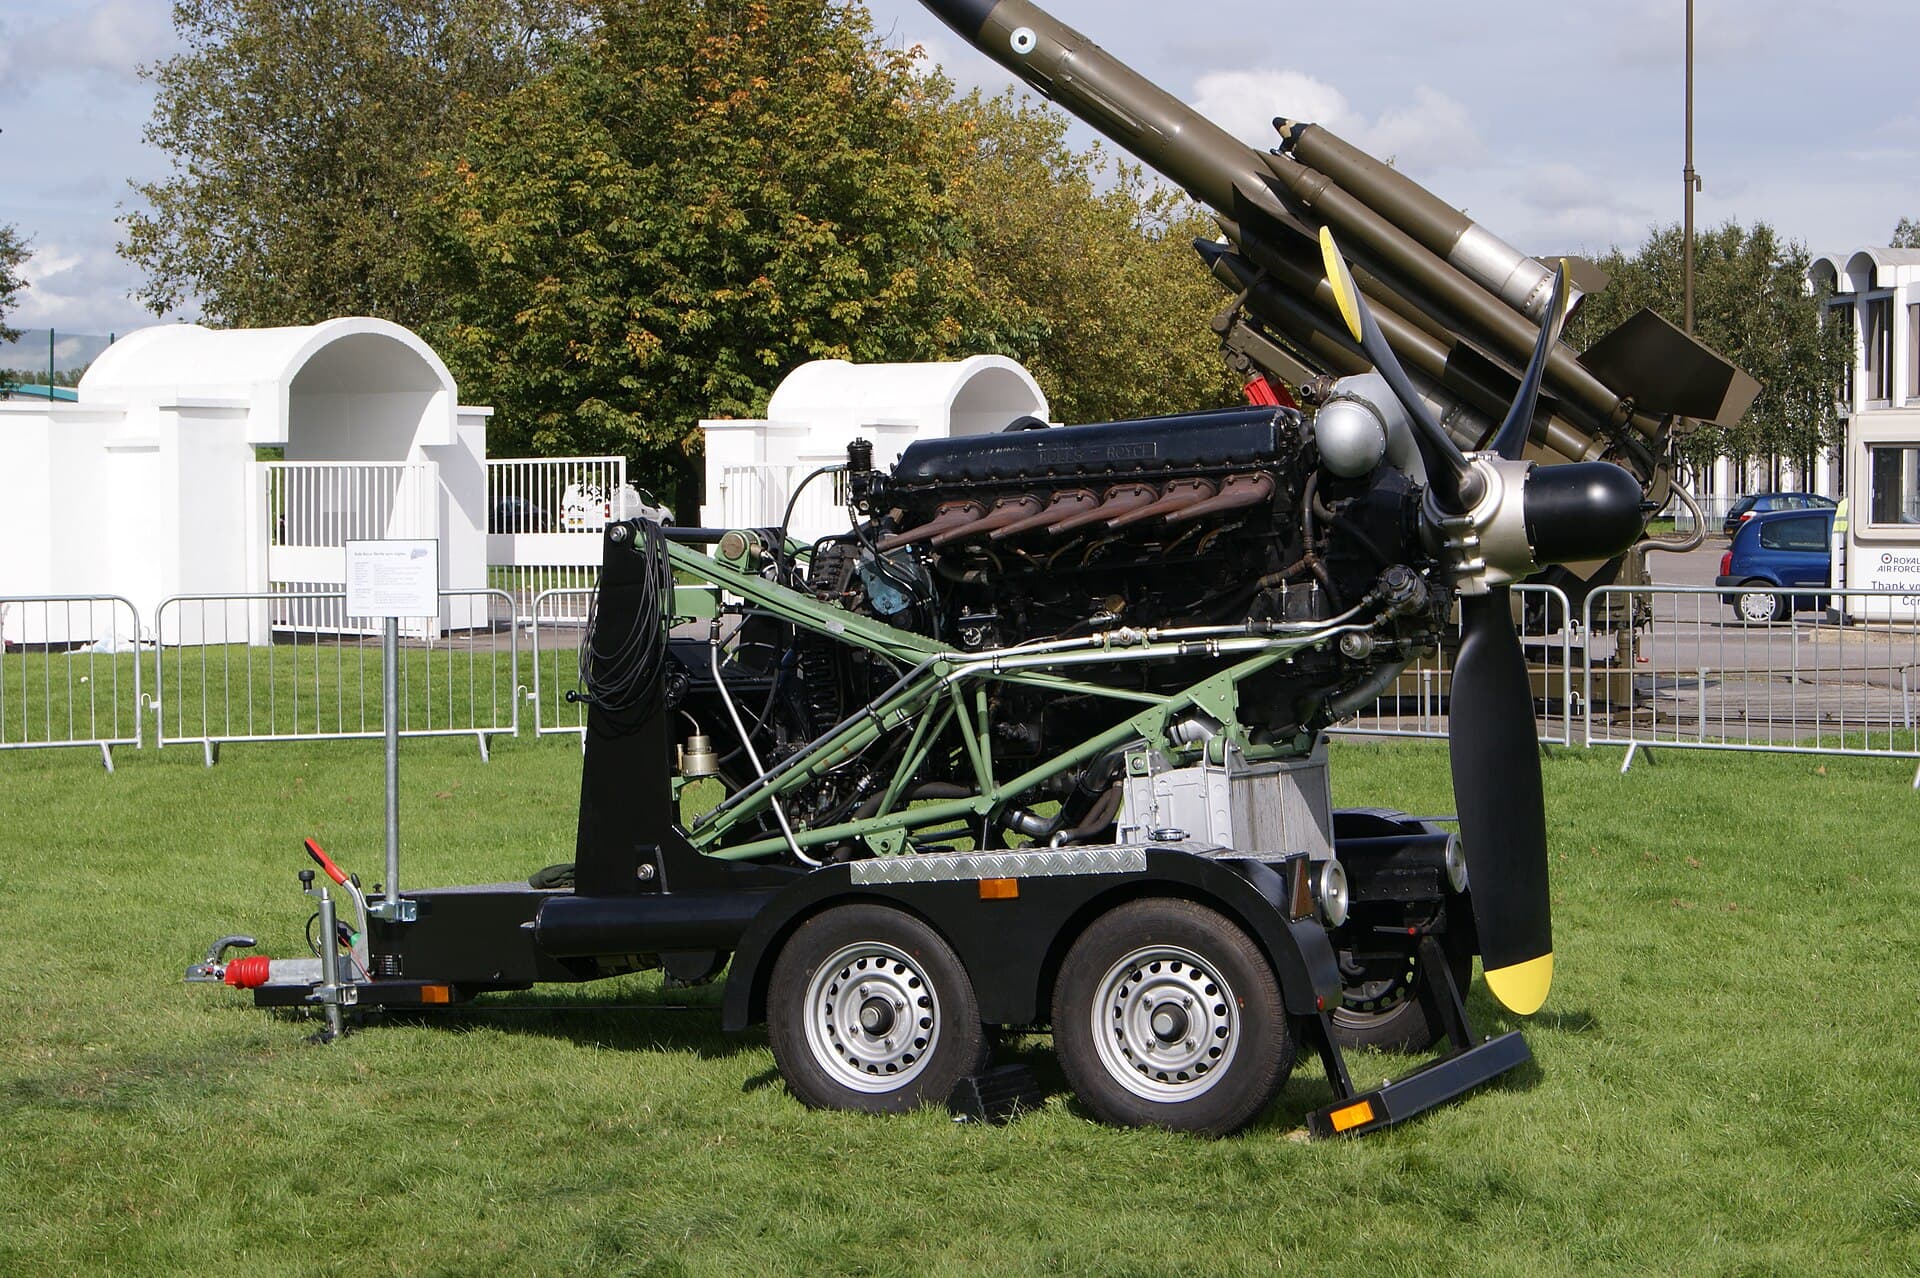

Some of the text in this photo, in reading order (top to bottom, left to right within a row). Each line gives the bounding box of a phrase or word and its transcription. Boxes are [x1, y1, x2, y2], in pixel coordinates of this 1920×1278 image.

[1893, 557, 1920, 565] ROYAL
[1893, 565, 1920, 573] FORCE
[1871, 580, 1905, 591] Thank
